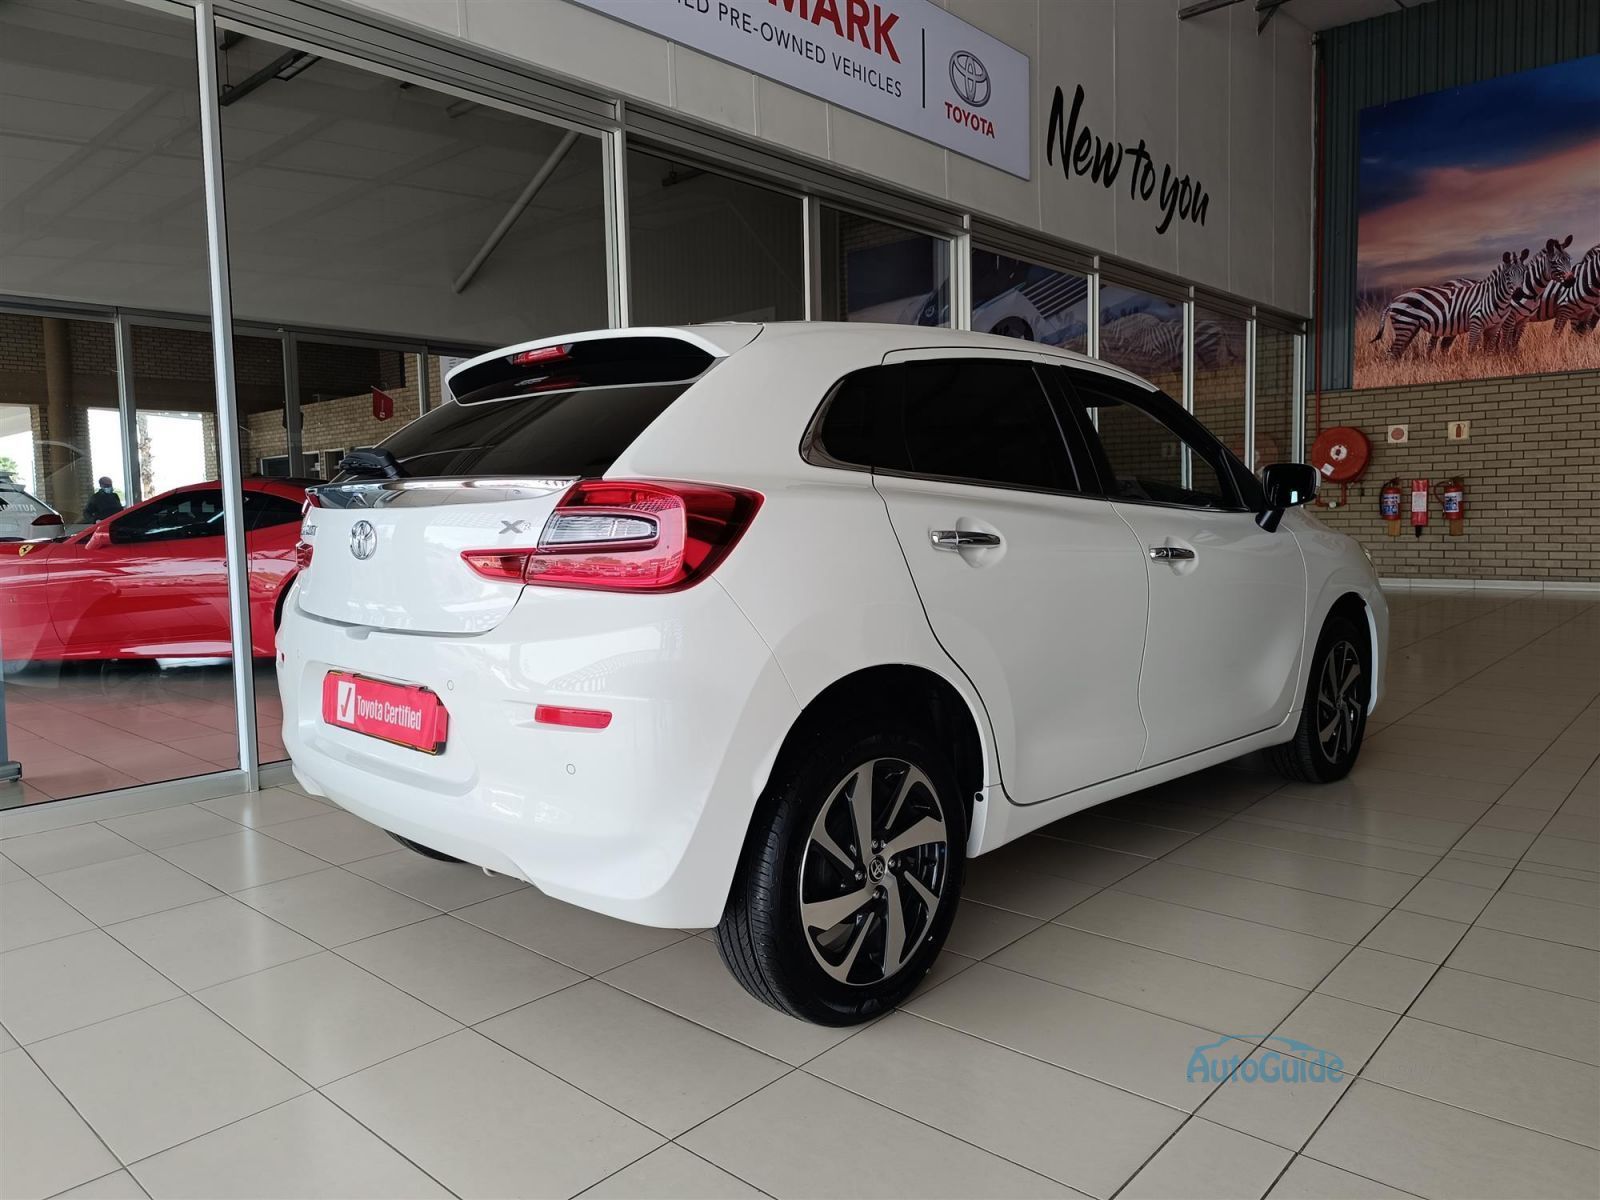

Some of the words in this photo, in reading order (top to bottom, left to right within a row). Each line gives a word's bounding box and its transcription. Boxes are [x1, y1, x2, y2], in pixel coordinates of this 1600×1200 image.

[718, 2, 826, 64] PRE-OWNED
[832, 52, 902, 98] VEHICLES
[945, 101, 995, 139] TOYOTA
[1047, 84, 1123, 189] New
[1125, 139, 1156, 201] to
[1155, 163, 1210, 234] you
[357, 695, 383, 721] Toyota
[384, 702, 422, 731] Certified
